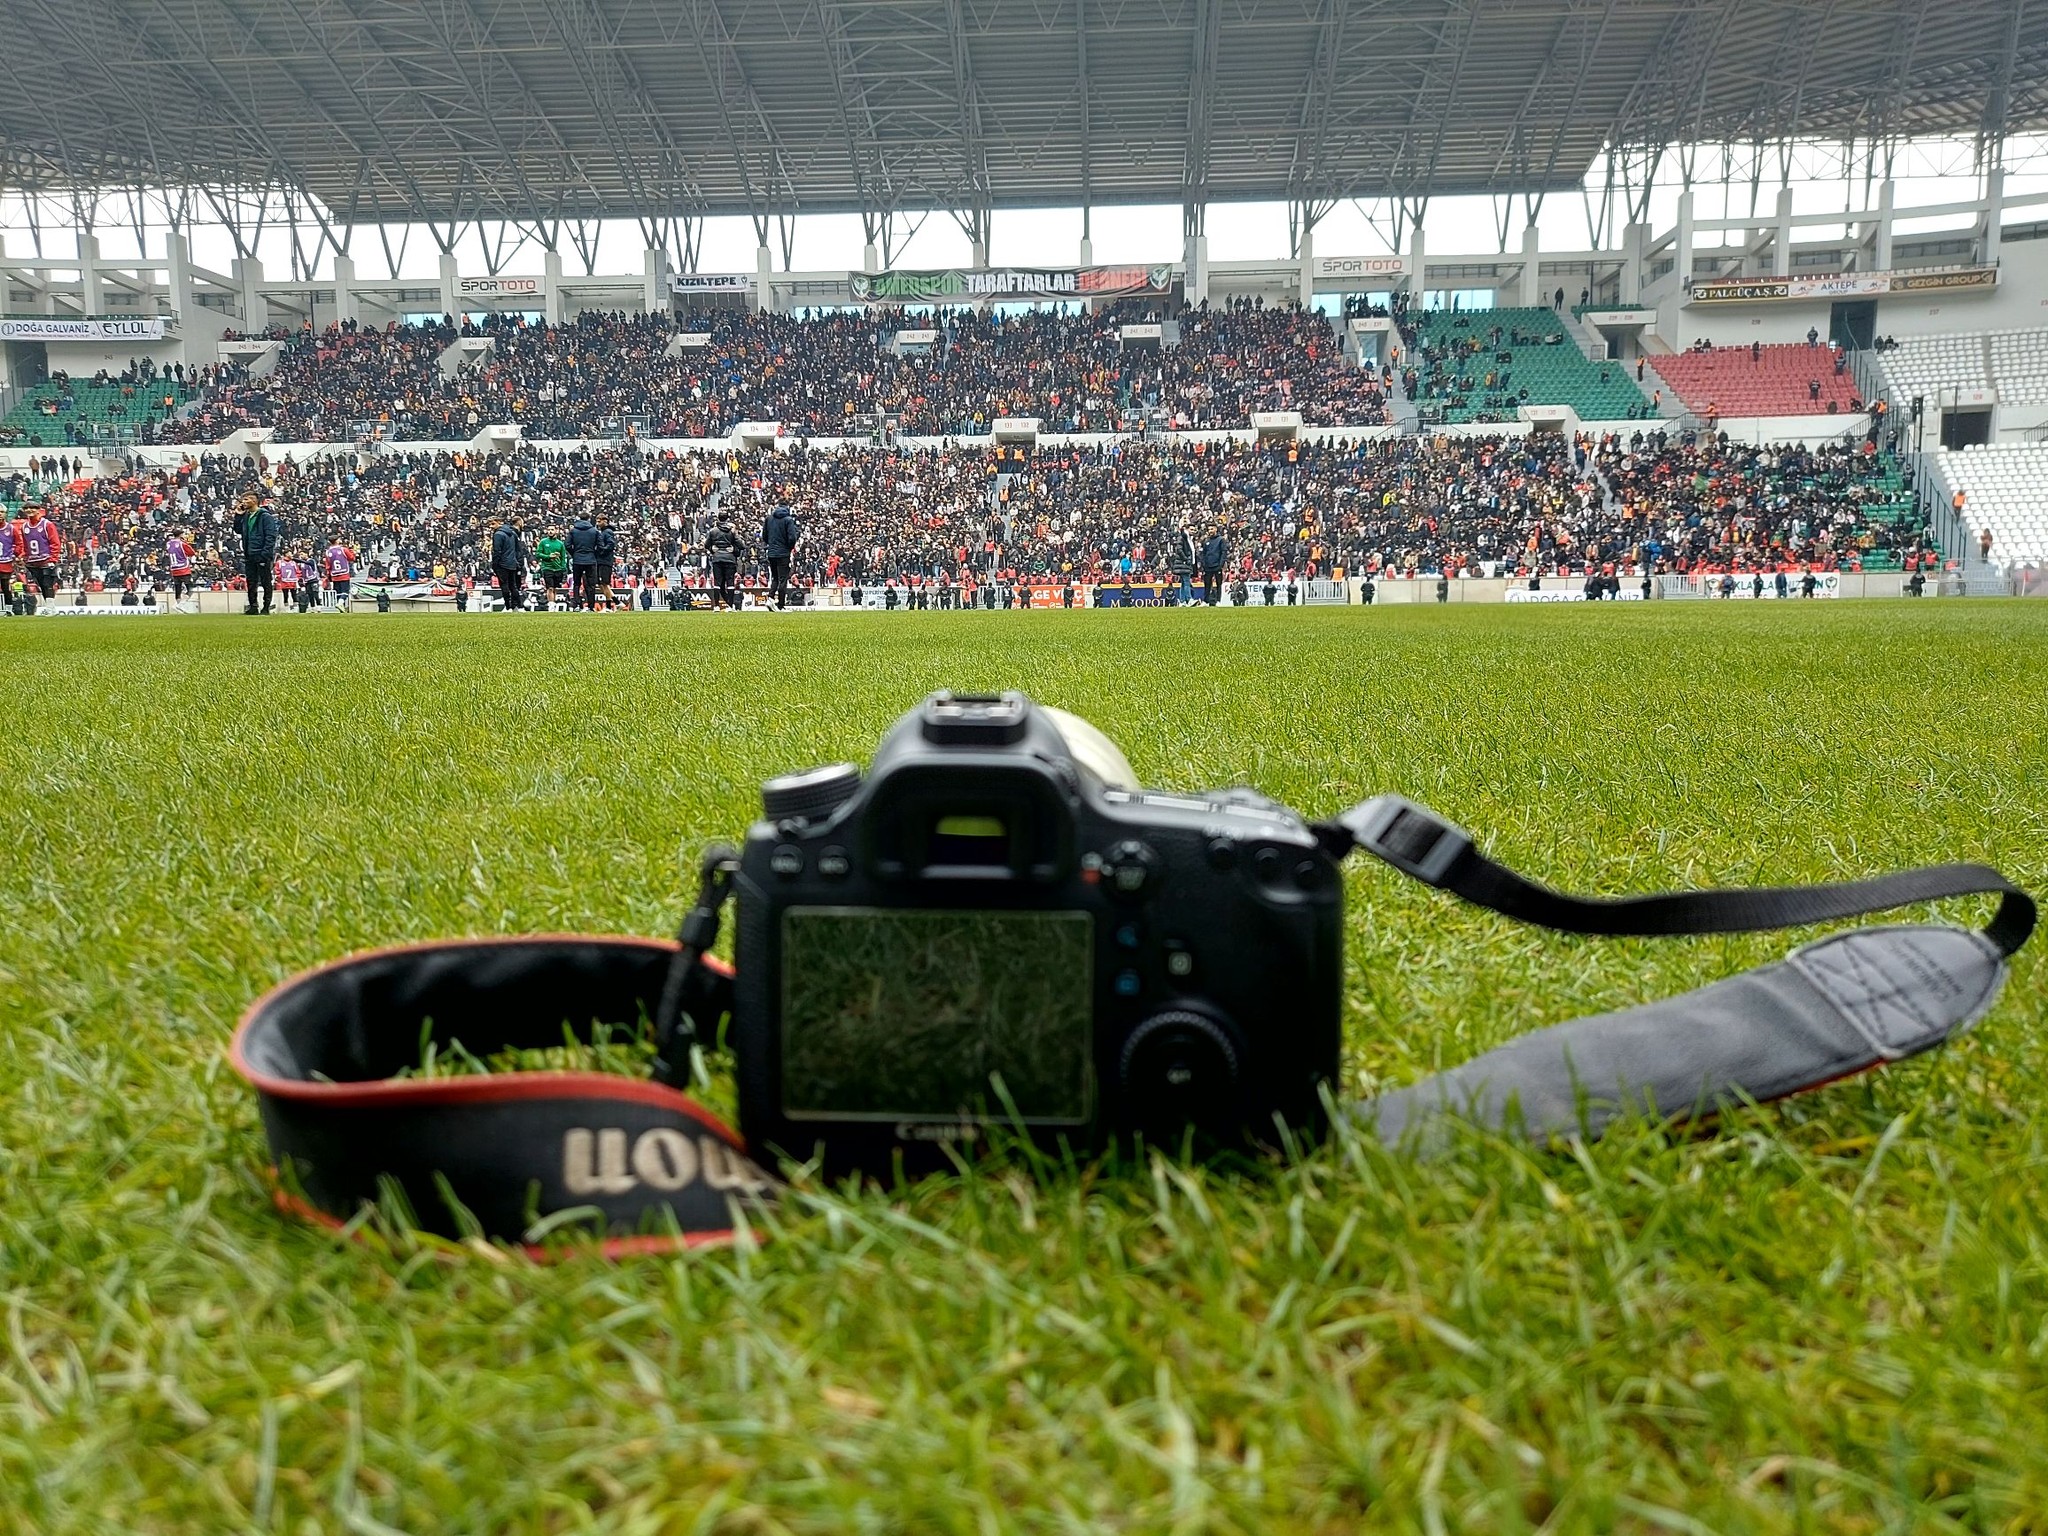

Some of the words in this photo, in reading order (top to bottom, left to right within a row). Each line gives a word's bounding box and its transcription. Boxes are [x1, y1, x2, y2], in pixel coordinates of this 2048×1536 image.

[966, 272, 1075, 292] TARAFTARLAR
[1821, 280, 1858, 291] AKTEPE
[1945, 274, 1982, 286] GROUP
[1709, 284, 1753, 299] PALGÜÇ
[16, 321, 45, 333] DOĞA
[45, 322, 90, 333] GALVANİZ
[102, 321, 149, 335] EYLÜL
[30, 540, 40, 555] 9
[169, 553, 177, 565] 11
[333, 560, 342, 571] 6
[285, 569, 292, 579] 7
